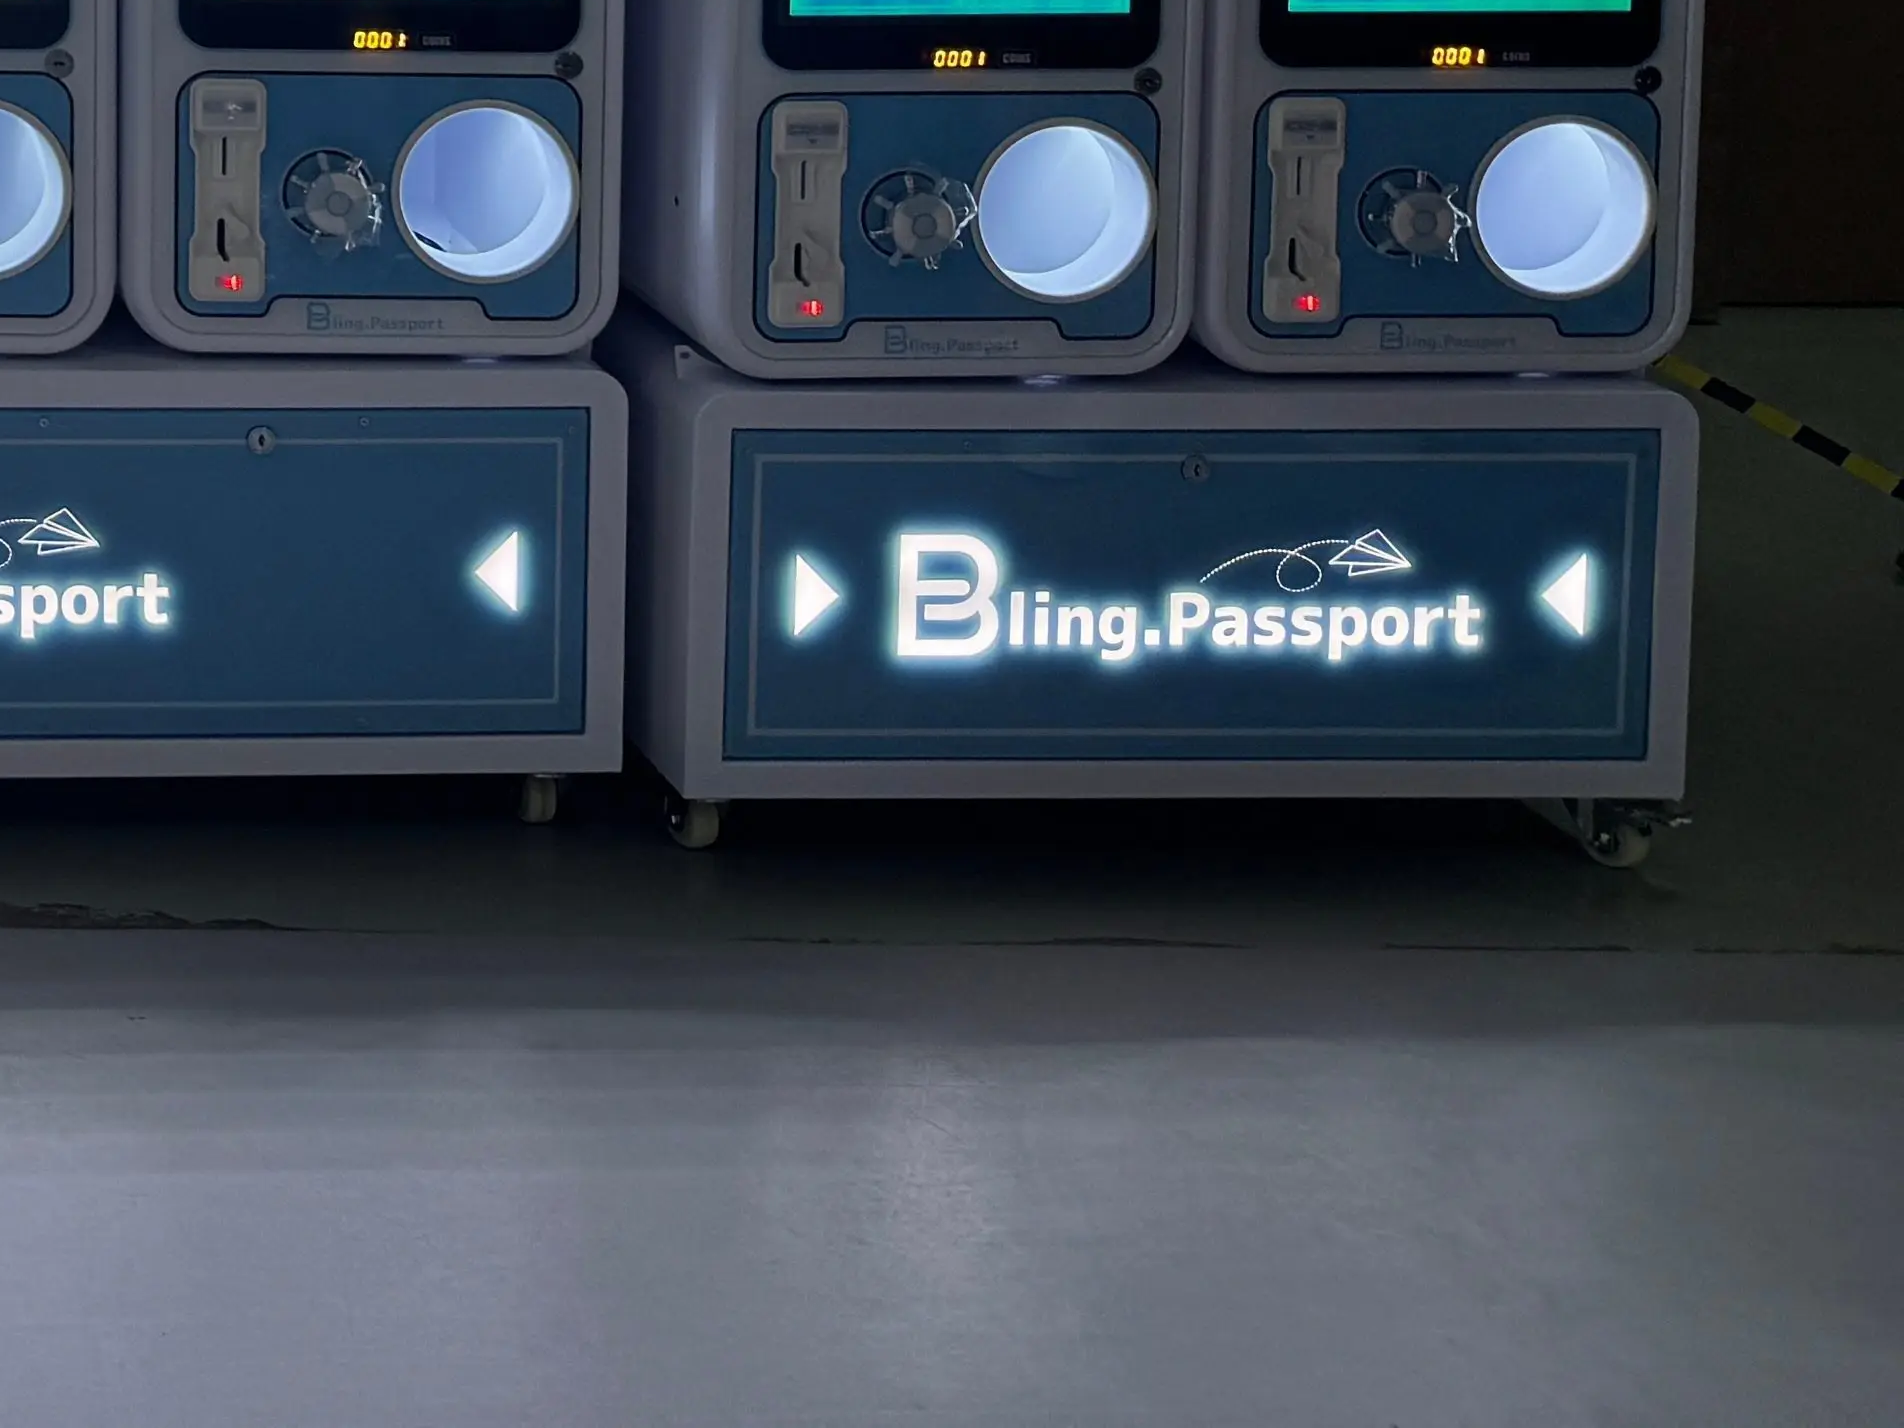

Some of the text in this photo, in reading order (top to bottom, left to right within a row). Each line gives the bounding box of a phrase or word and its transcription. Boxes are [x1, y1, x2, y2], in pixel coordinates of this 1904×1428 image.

[934, 50, 985, 67] 0001
[1432, 47, 1484, 65] 0001
[896, 533, 1482, 661] Bling.Passport
